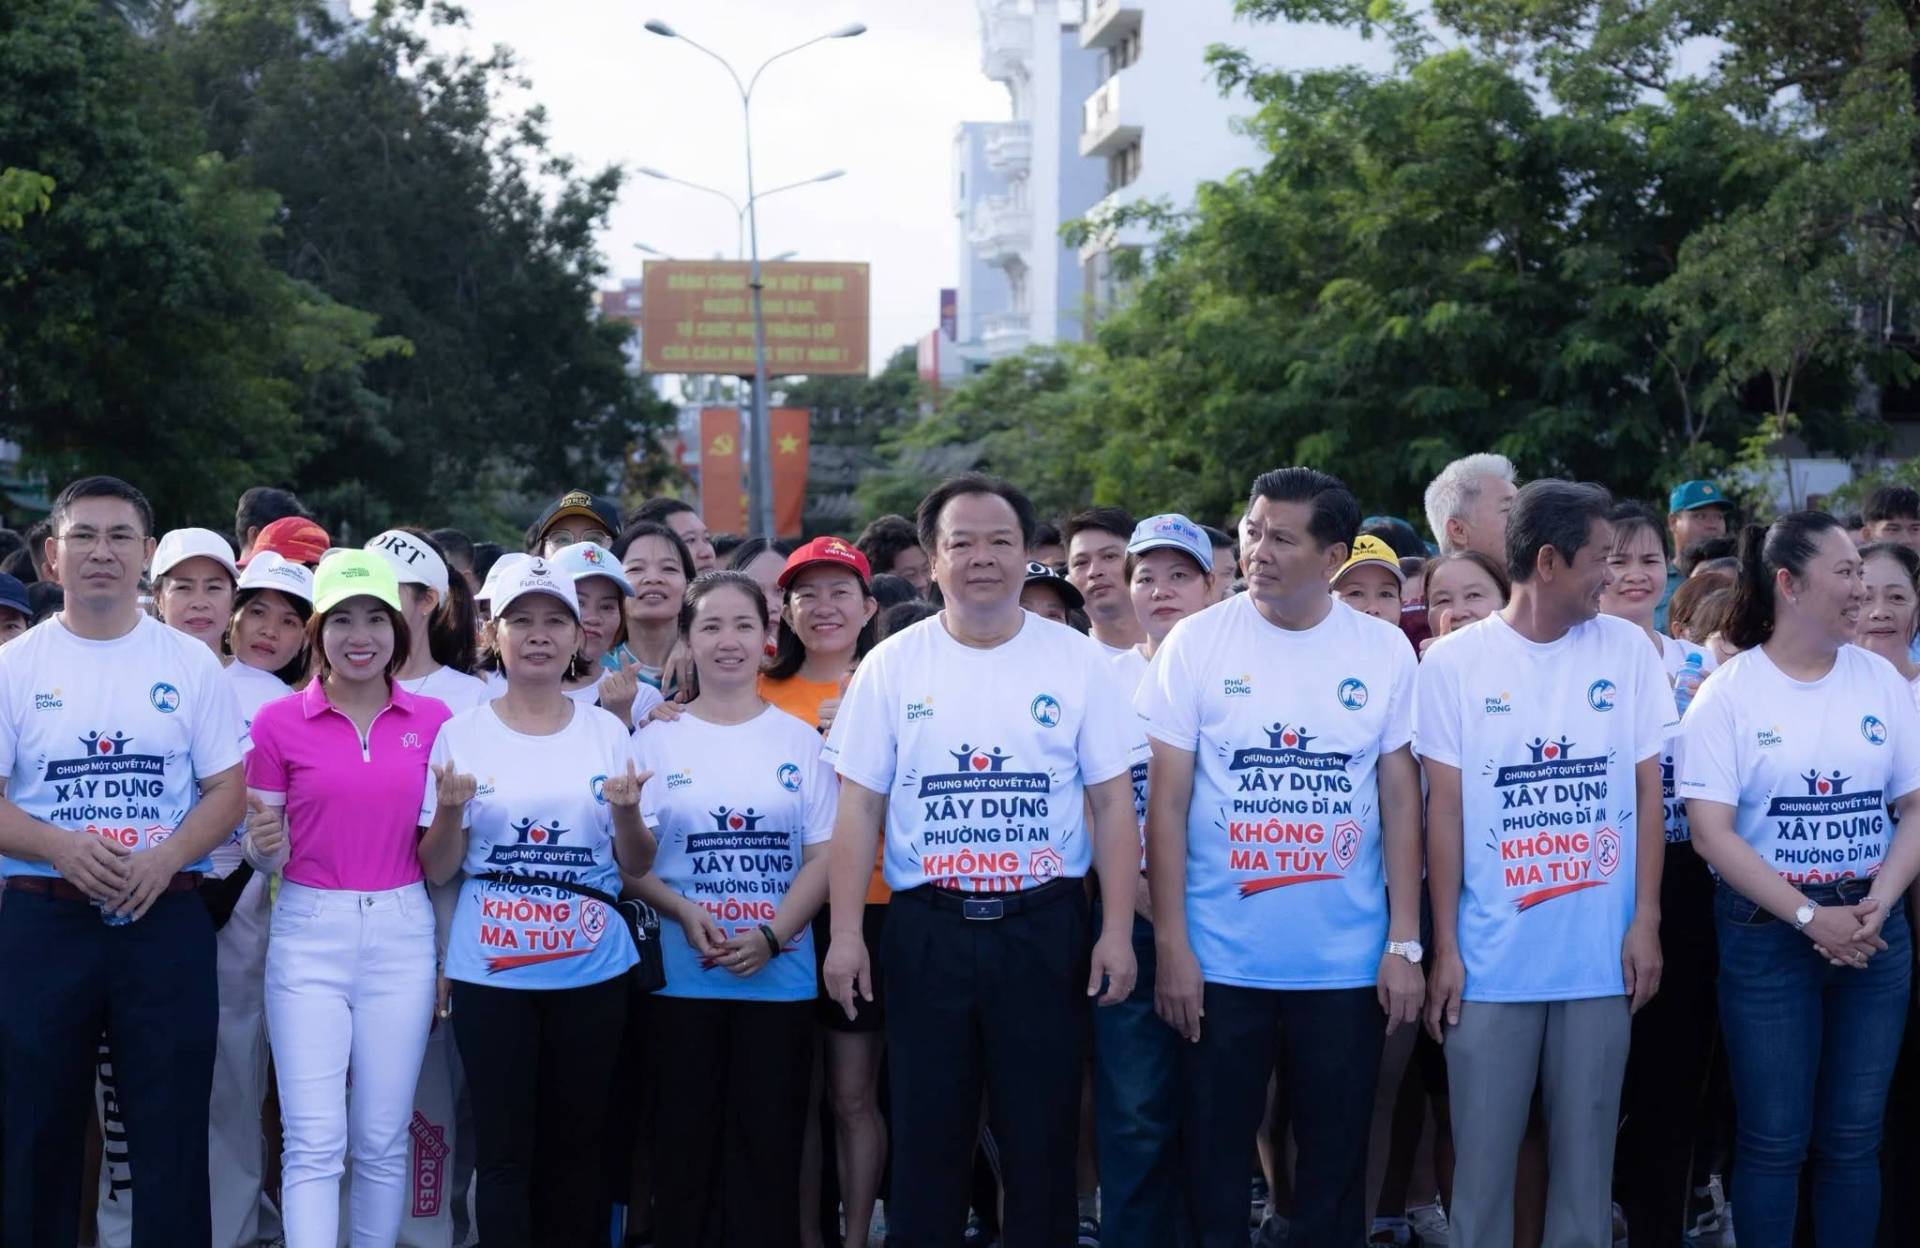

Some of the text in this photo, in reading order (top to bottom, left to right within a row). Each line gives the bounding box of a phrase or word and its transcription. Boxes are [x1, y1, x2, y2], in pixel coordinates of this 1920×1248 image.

[56, 757, 160, 775] CHUNG MỘT QUYẾT TÂM
[1243, 754, 1344, 767] CHUNG MỘT QUYẾT TÂM
[1505, 763, 1607, 781] CHUNG MỘT QUYẾT TÂM
[55, 777, 164, 803] XÂY DỰNG
[927, 776, 1046, 791] CHUNG MỘT QUYẾT TÂM
[1237, 768, 1352, 797] XÂY DỰNG
[1502, 781, 1607, 809] XÂY DỰNG
[50, 804, 123, 821] PHƯỜNG
[141, 806, 160, 819] AN
[924, 795, 1049, 824] XÂY DỰNG
[1233, 797, 1352, 814] PHƯỜNG DĨ AN
[1780, 796, 1879, 813] CHUNG MỘT QUYẾT TÂM
[1229, 818, 1325, 843] KHÔNG
[1503, 807, 1606, 832] PHƯỜNG DĨ AN
[1777, 815, 1883, 844] XÂY DỰNG
[692, 835, 790, 849] CHUNG MỘT QUYẾT TÂM
[924, 824, 1049, 846] PHƯỜNG DĨ AN
[1500, 832, 1590, 860] KHÔNG
[520, 848, 543, 861] MỘT
[543, 850, 576, 863] QUYẾT
[692, 852, 793, 878] XÂY DỰNG
[922, 848, 1020, 876] KHÔNG
[1230, 846, 1328, 871] MA TÚY
[1775, 843, 1880, 864] PHƯỜNG DĨ AN
[1504, 857, 1592, 887] MA TÚY
[695, 878, 759, 894] PHƯỜNG
[762, 878, 776, 894] DĨ
[483, 898, 571, 923] KHÔNG
[693, 898, 776, 921] HÔNG
[480, 923, 577, 950] MA TÚY
[411, 1116, 445, 1158] HEROES
